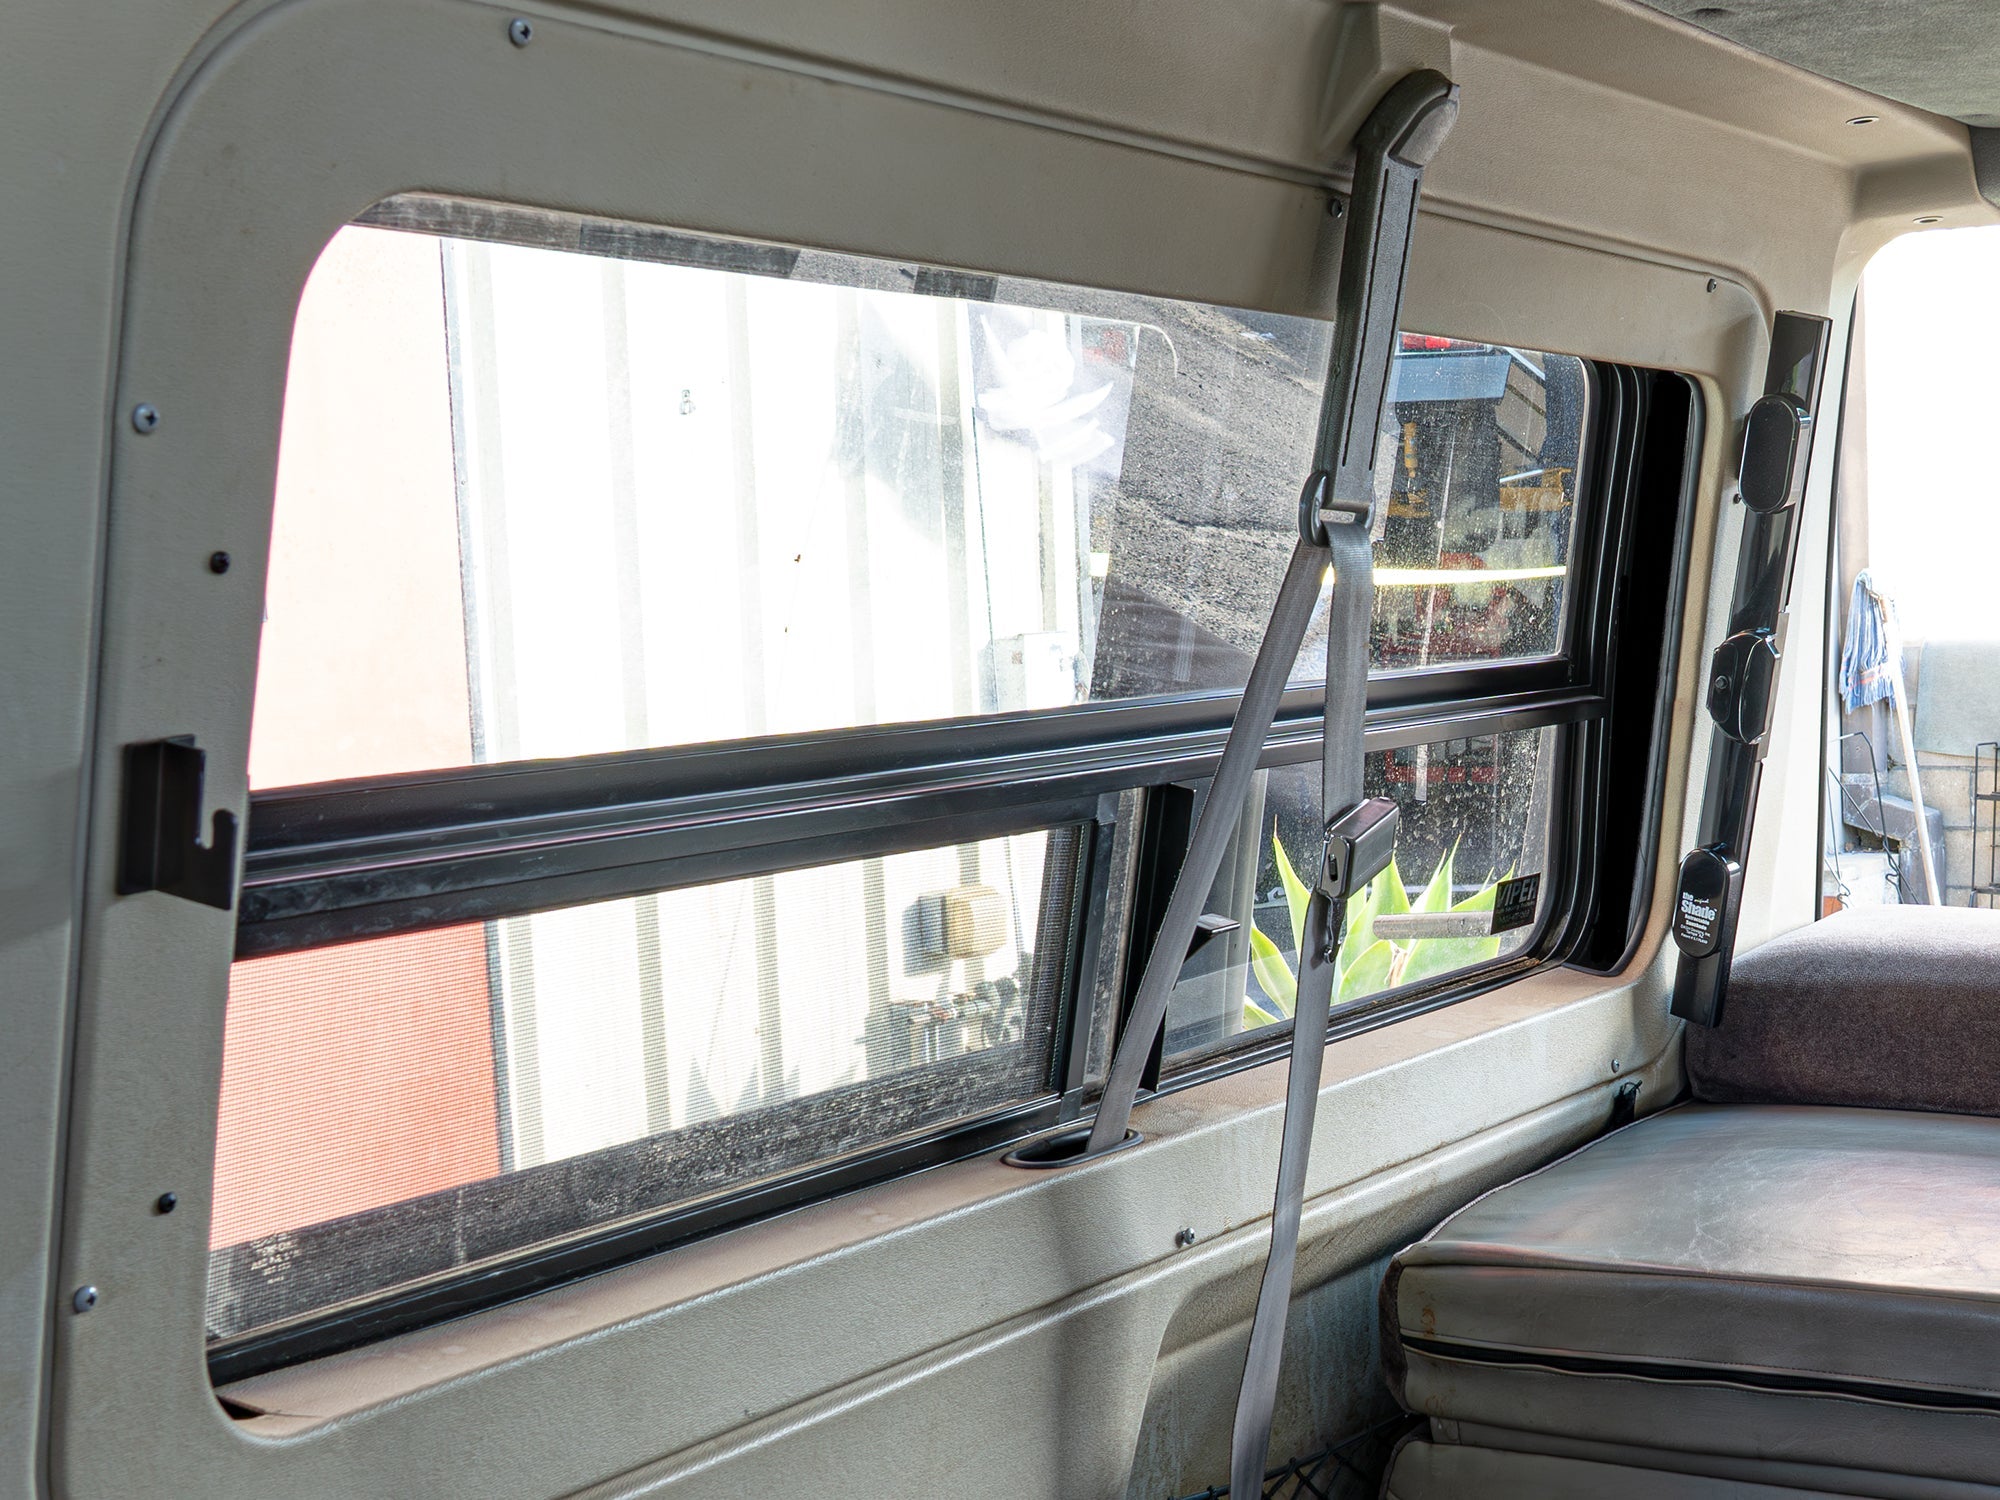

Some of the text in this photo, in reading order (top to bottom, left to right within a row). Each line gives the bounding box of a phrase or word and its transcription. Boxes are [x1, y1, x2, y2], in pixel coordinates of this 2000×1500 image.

[1497, 878, 1537, 907] VIPER
[1683, 892, 1693, 900] the
[1681, 900, 1715, 920] Shade
